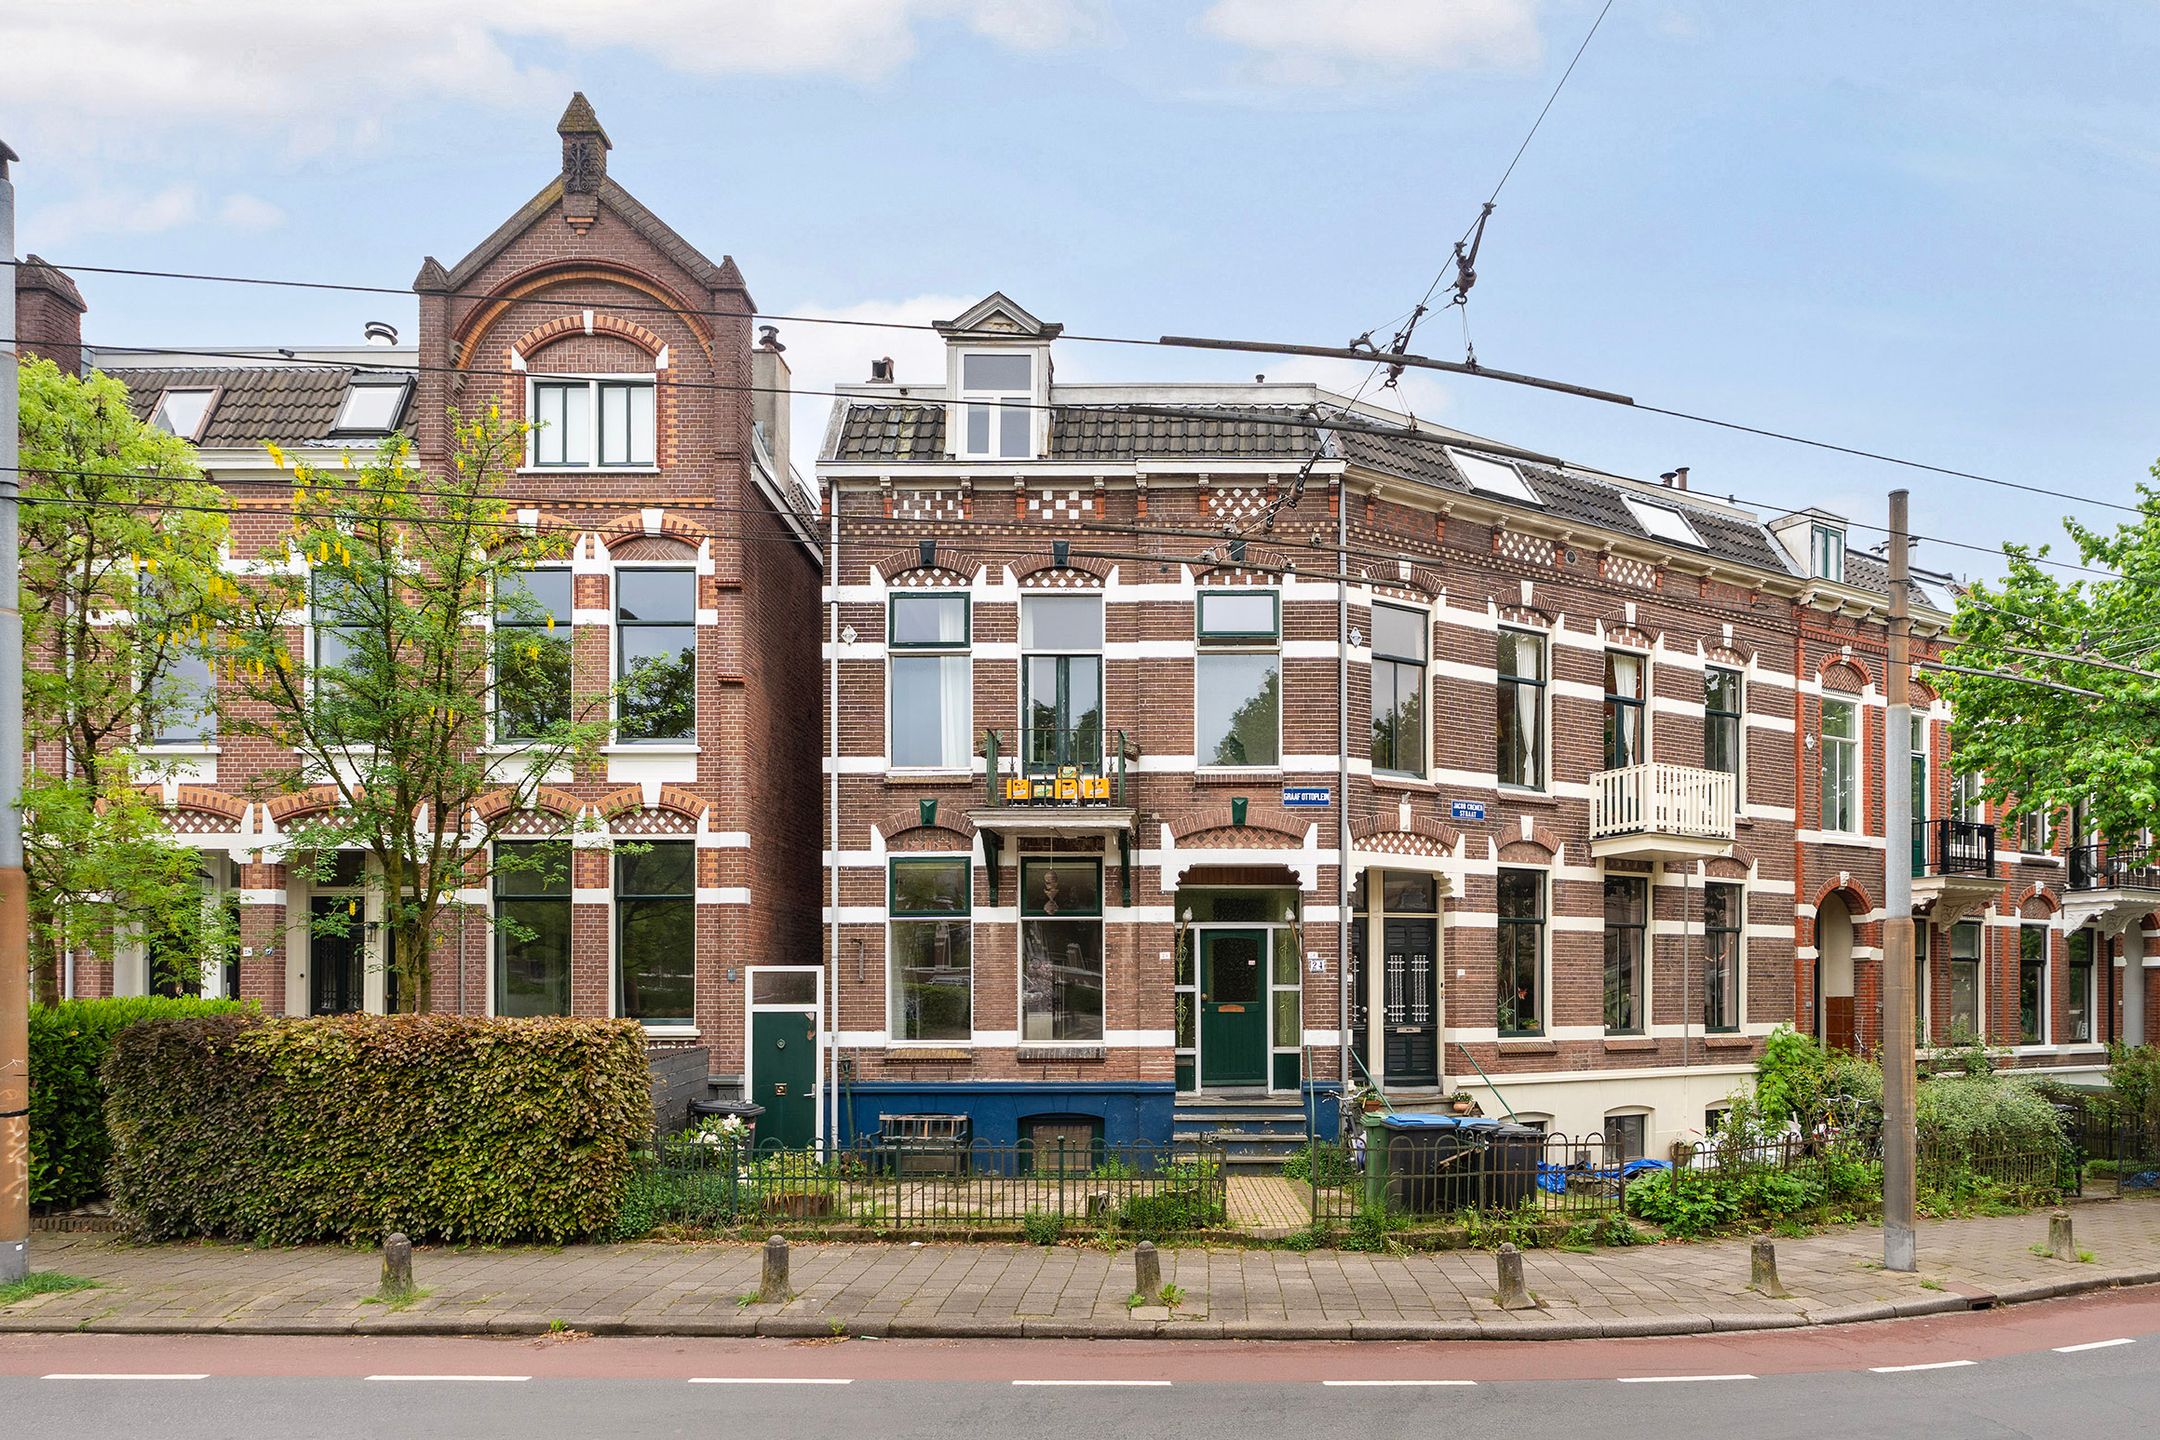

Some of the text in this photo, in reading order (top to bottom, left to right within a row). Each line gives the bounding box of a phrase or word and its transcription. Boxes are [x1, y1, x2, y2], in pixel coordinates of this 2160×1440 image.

[1283, 792, 1330, 801] GRAAF OTTOPLEIN
[1459, 810, 1477, 818] STRAAT
